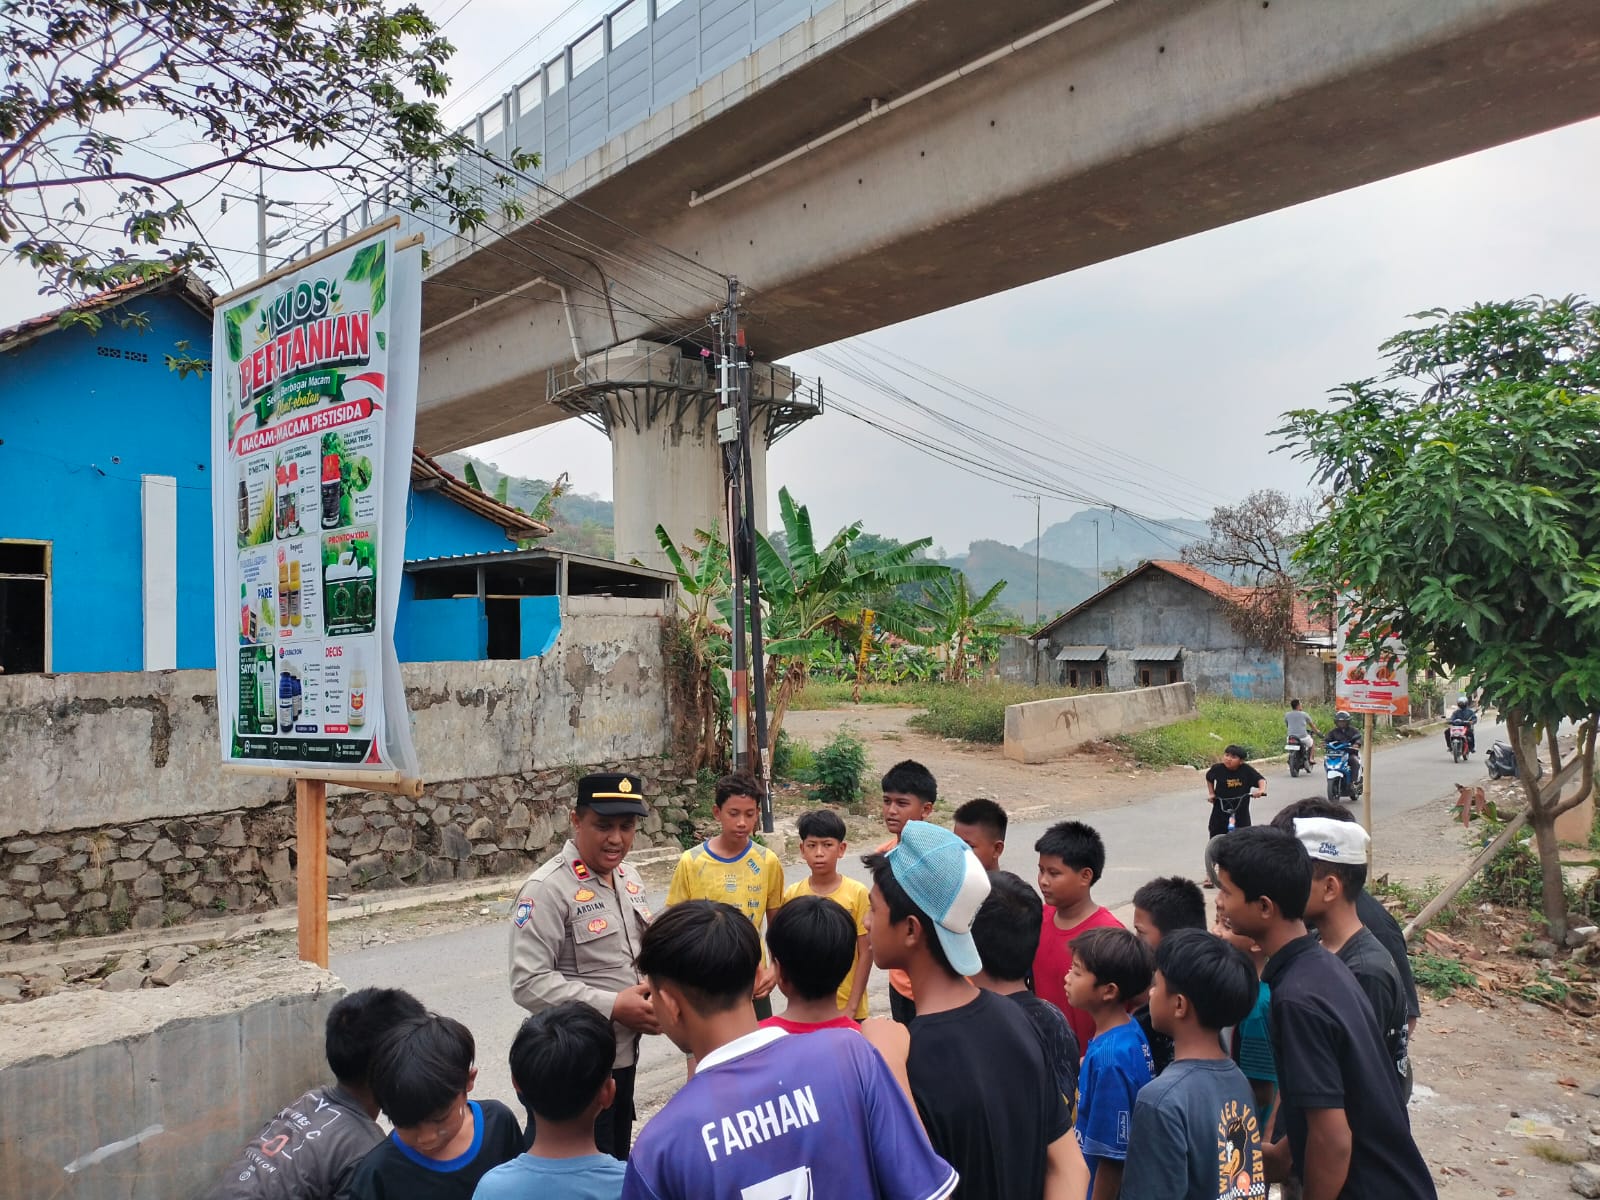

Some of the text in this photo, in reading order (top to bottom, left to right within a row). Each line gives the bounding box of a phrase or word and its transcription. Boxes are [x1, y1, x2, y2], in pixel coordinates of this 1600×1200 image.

[268, 279, 329, 337] KIOS
[239, 311, 370, 404] PERTANIAN
[308, 376, 331, 386] Macam
[241, 403, 362, 453] MACAM-MACAM PESTISIDA
[258, 587, 273, 599] PARE
[325, 646, 343, 657] DECIS
[576, 902, 605, 916] ARDIAN
[701, 1085, 820, 1162] FARHAN
[1242, 1104, 1261, 1144] YOU
[1252, 1149, 1266, 1183] ARE
